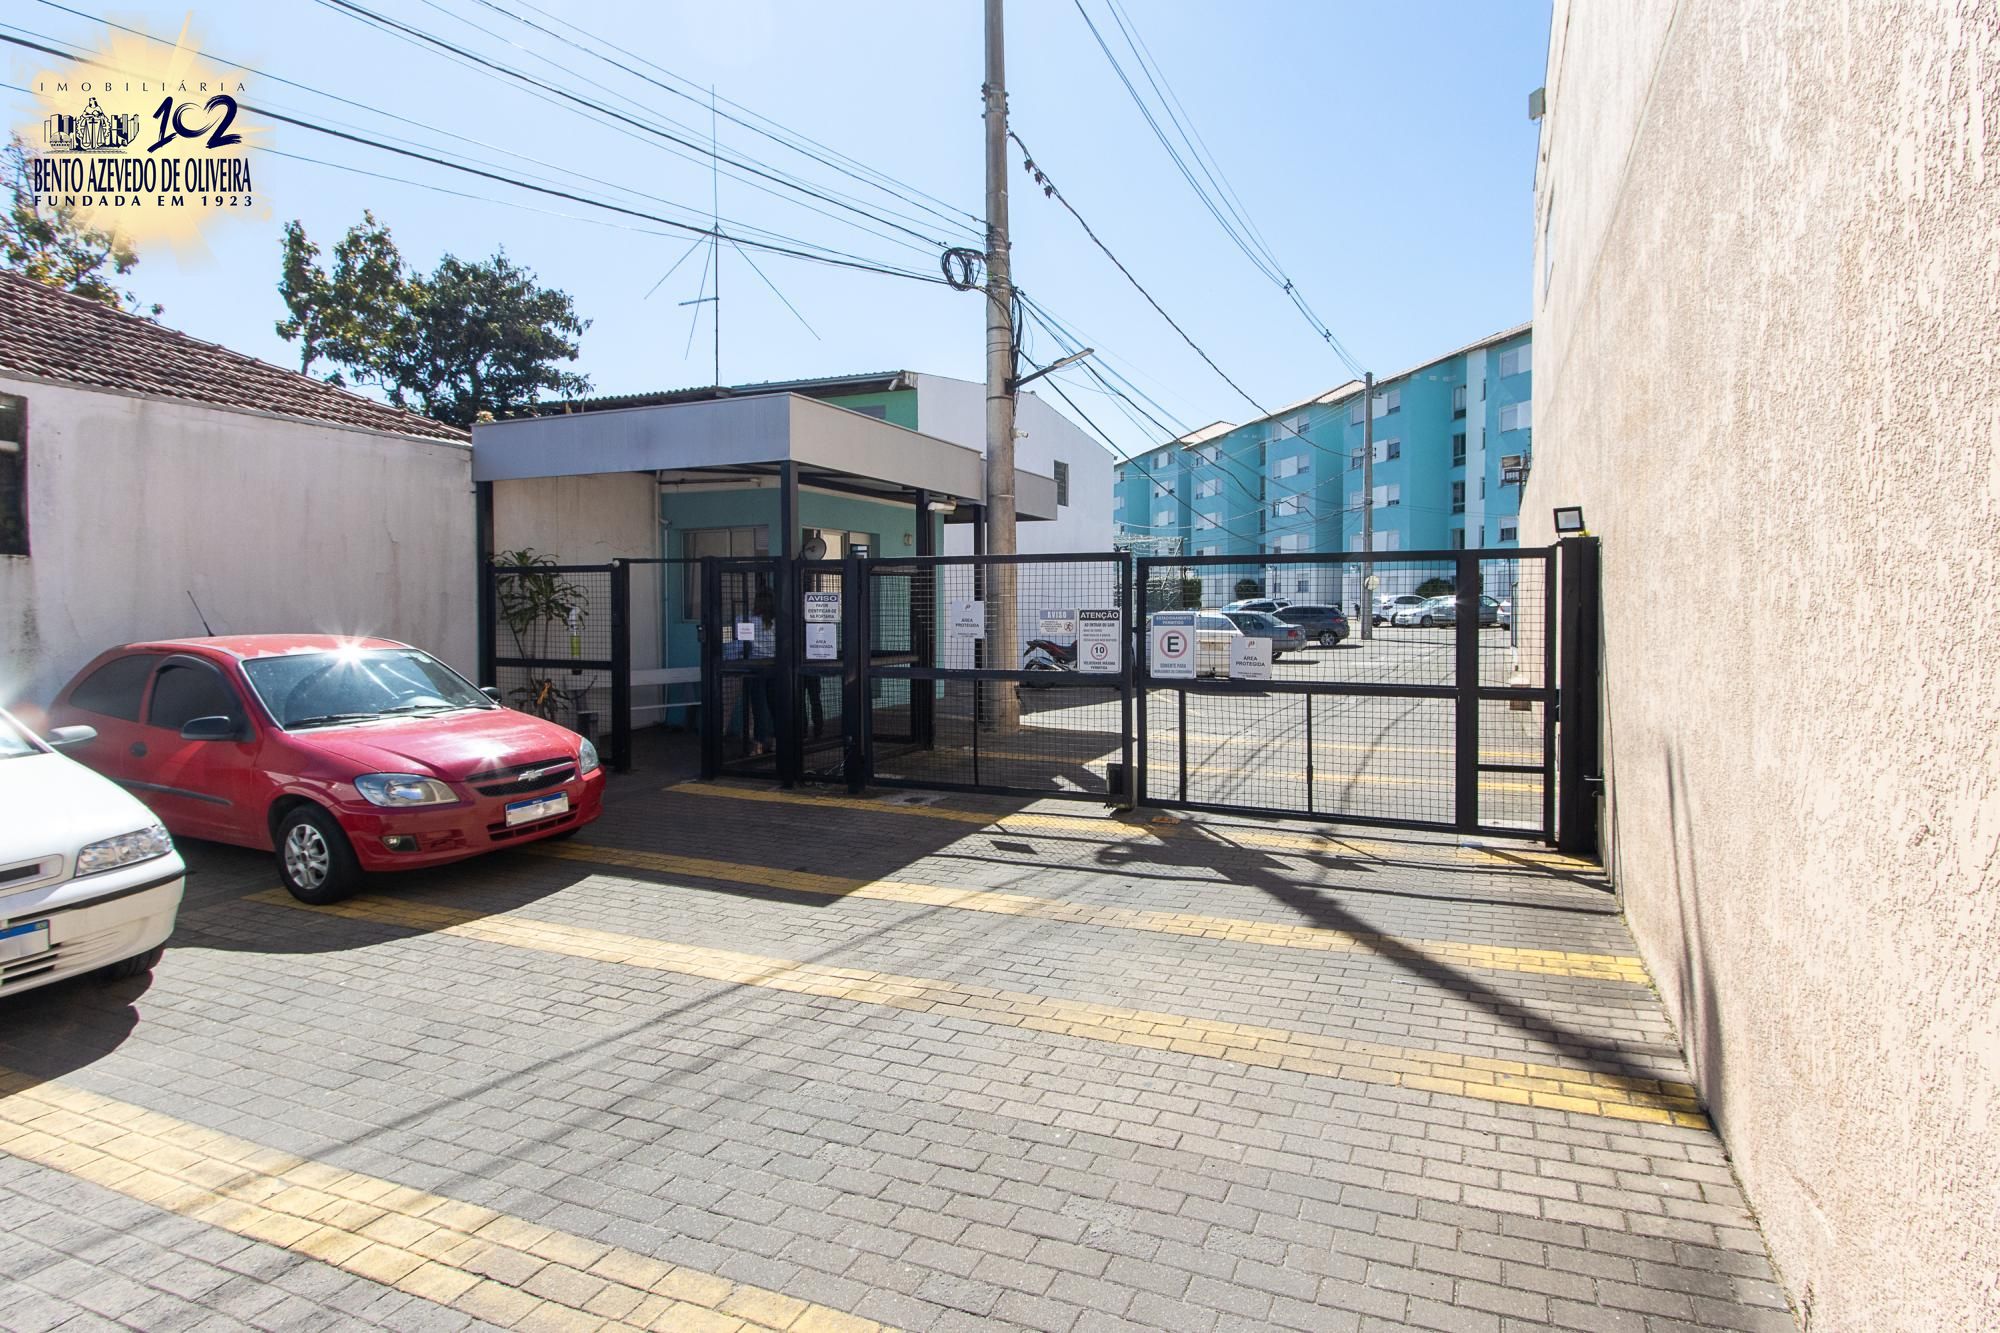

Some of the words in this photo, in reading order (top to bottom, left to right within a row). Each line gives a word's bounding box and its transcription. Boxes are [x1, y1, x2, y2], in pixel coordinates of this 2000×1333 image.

[1047, 611, 1067, 619] AVISO
[1080, 610, 1119, 620] ATENÇÃO
[1167, 635, 1180, 653] E
[1094, 646, 1105, 654] 10
